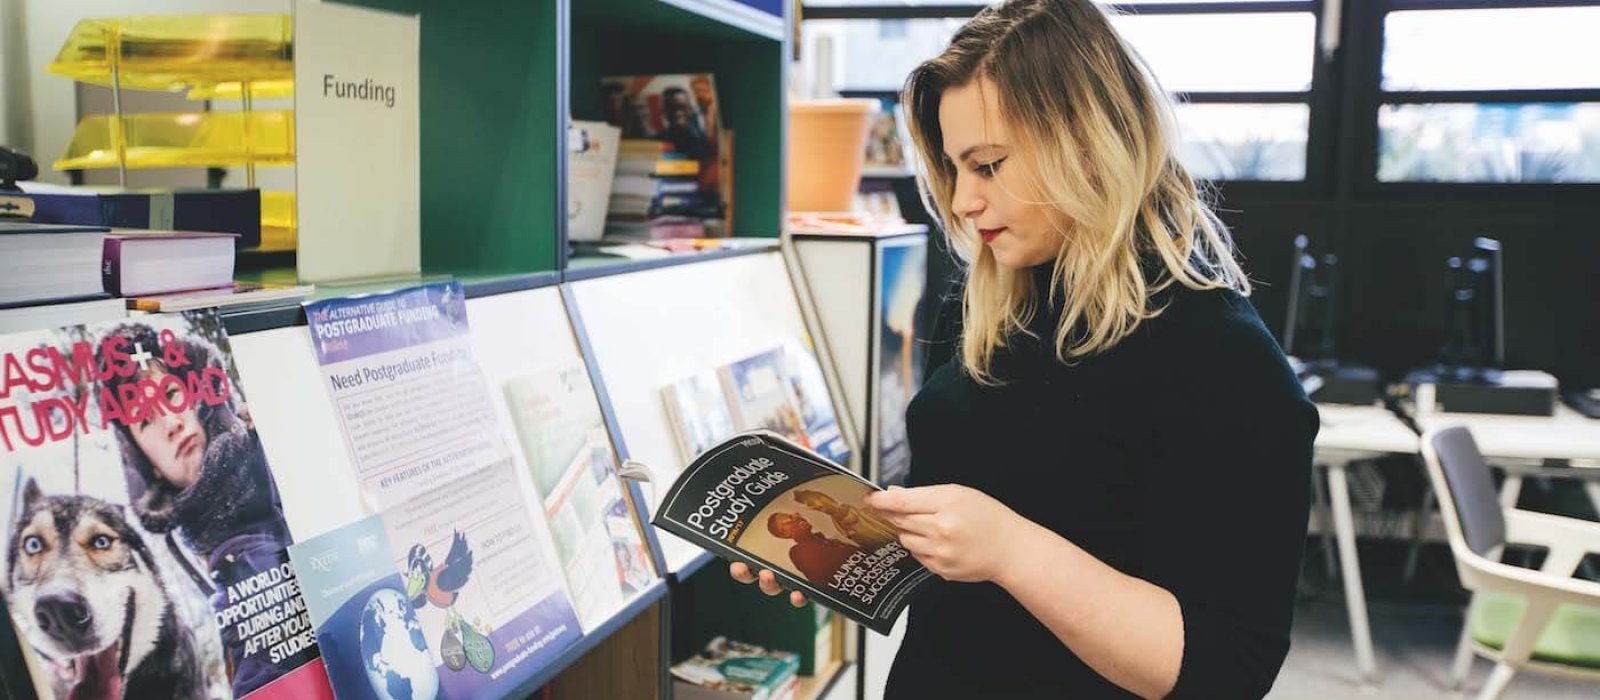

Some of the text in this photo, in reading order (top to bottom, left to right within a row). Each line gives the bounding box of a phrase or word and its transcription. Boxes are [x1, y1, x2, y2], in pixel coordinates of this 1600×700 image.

[323, 74, 395, 108] Funding
[315, 304, 440, 339] POSTGRADUATE FUNDING
[329, 302, 375, 320] ALTERNATIVE
[0, 328, 192, 400] ASMUS+ &
[330, 369, 362, 391] Need
[363, 355, 430, 381] Postgraduate
[0, 366, 229, 452] TUDY ABROAD
[687, 457, 774, 530] Postgraduate
[709, 471, 790, 539] Study Guide
[227, 586, 240, 603] A
[235, 567, 281, 598] WORLD
[828, 550, 867, 589] LAUNCH
[839, 541, 901, 593] YOUR JOURNEY
[849, 584, 866, 598] TO
[861, 549, 908, 585] POSTGRAD
[861, 566, 900, 605] SUCCESS
[215, 579, 301, 629] OPPORTUNITIES
[237, 605, 285, 641] DURING
[243, 612, 311, 659] AFTER YOUR
[269, 630, 318, 664] STUDIES
